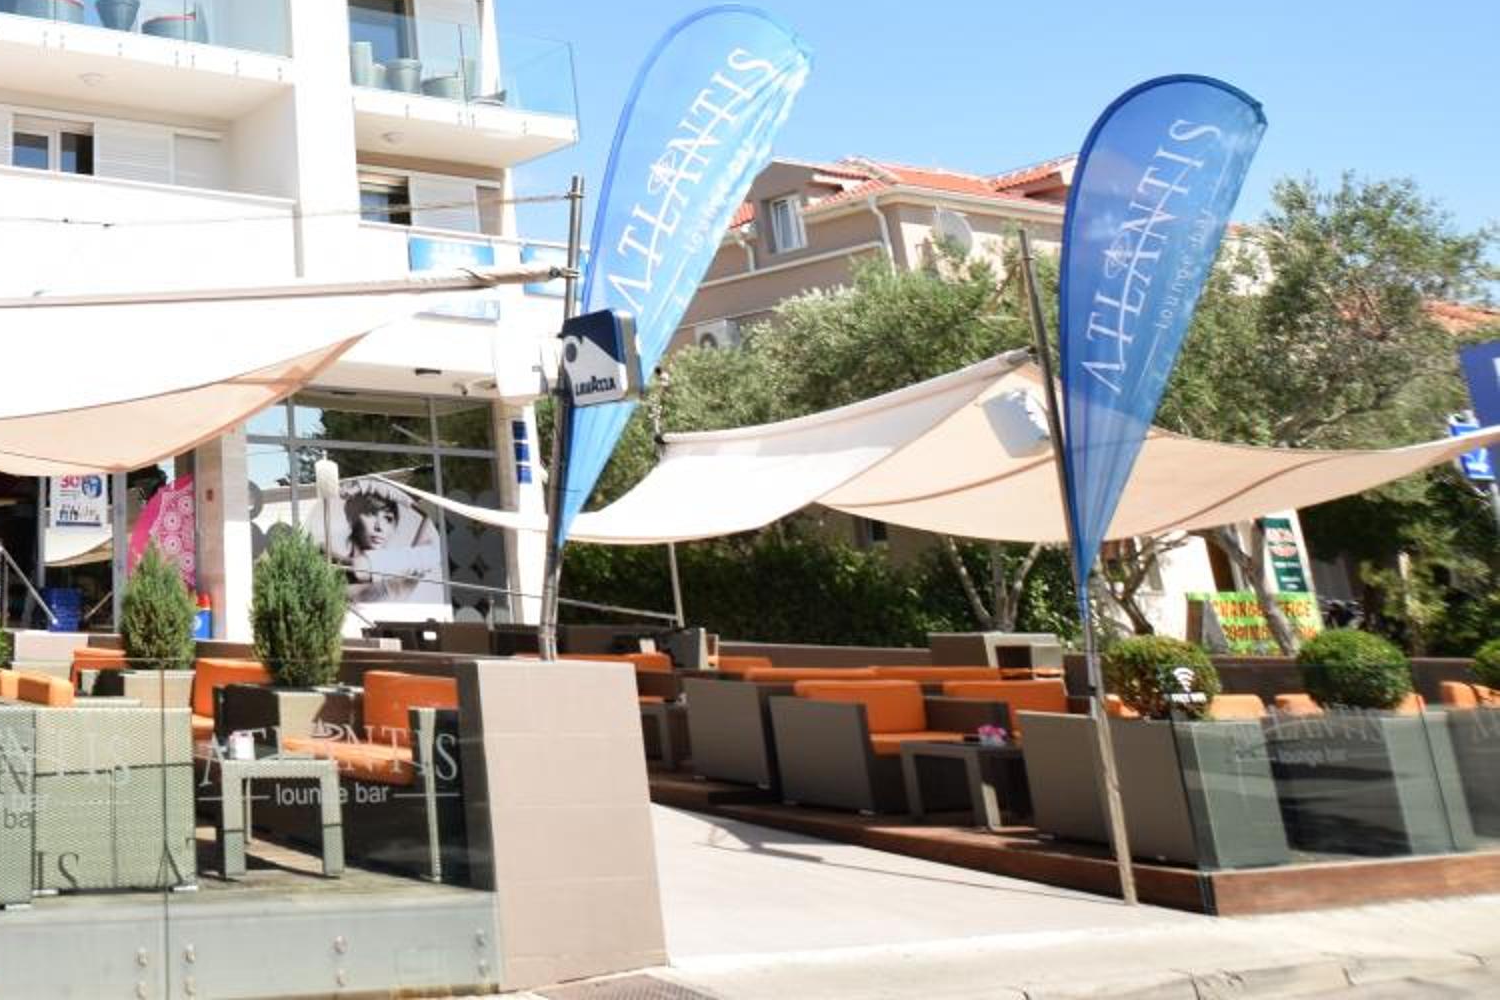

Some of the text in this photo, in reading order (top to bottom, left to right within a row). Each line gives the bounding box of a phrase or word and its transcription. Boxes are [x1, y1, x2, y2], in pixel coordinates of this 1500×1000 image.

[606, 47, 776, 315] ATLANTIS
[1080, 118, 1222, 394] ATLANTIS
[355, 783, 389, 804] bar
